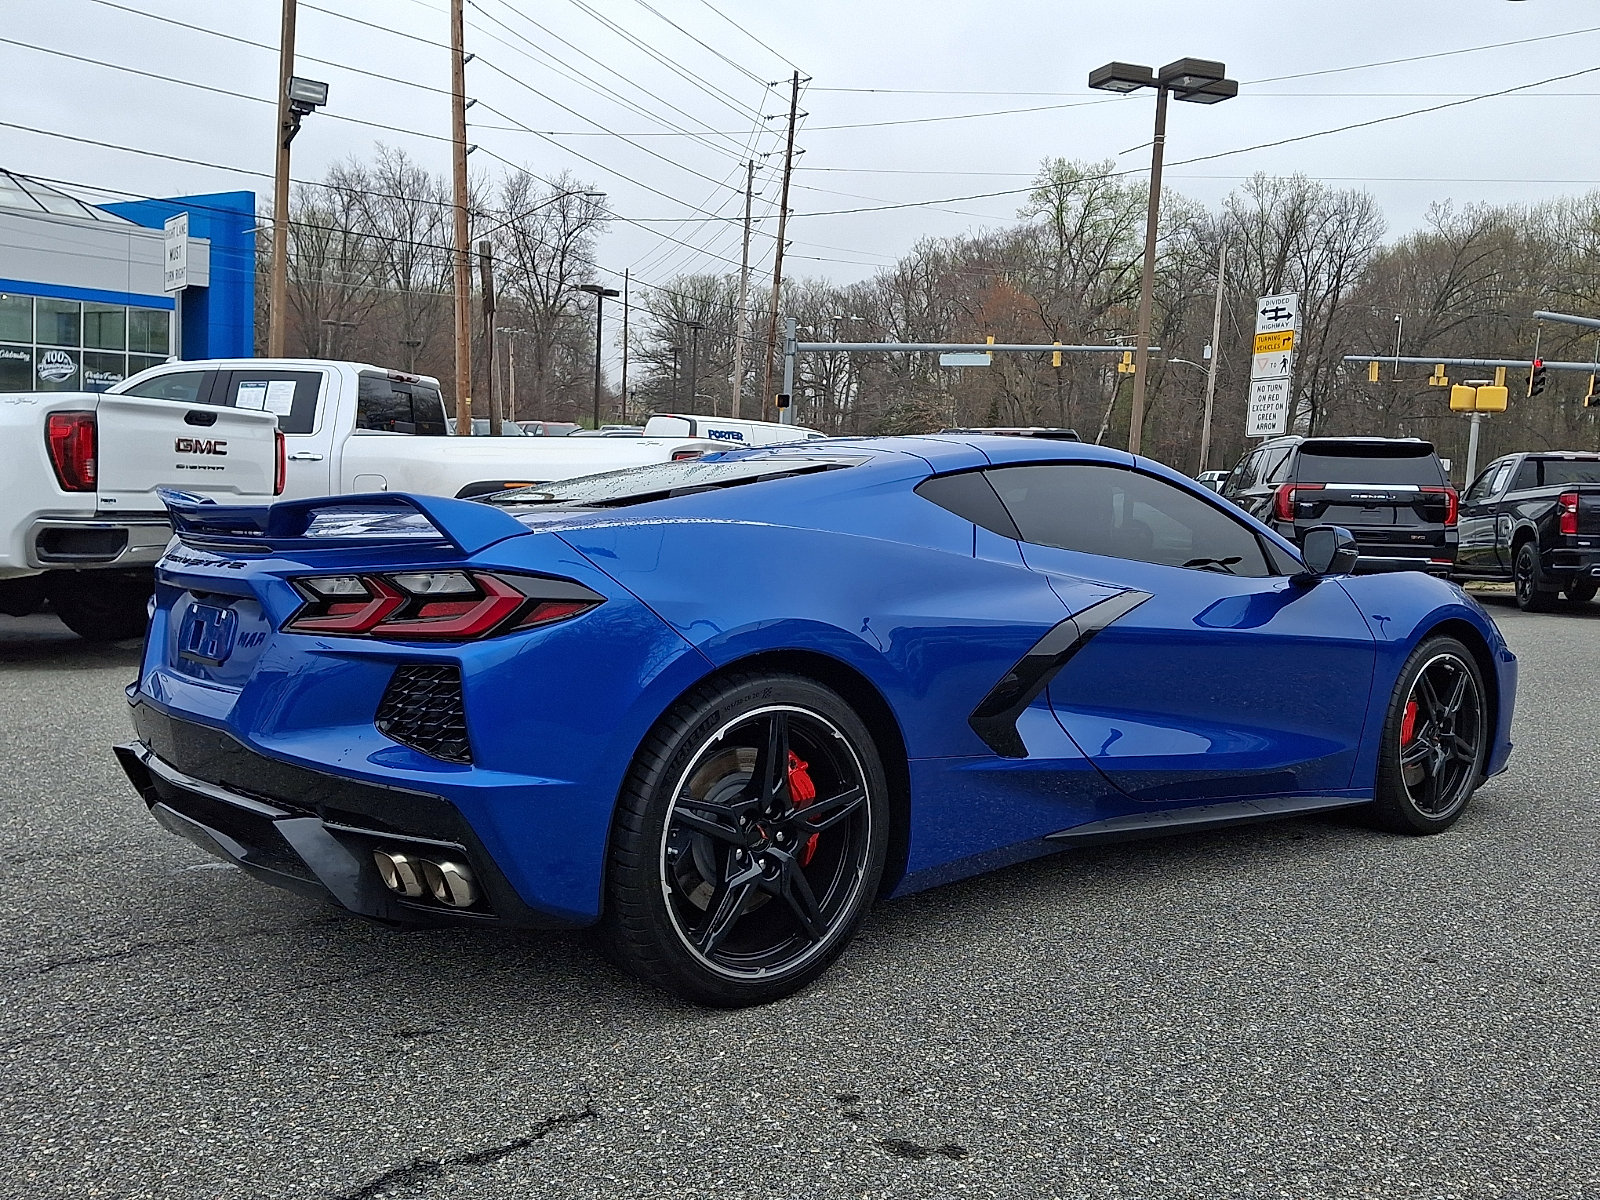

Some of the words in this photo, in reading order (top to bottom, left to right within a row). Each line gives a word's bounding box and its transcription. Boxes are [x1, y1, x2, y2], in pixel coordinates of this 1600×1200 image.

[170, 244, 181, 261] MUST
[1265, 298, 1289, 306] DIVIDED
[1261, 321, 1289, 330] HIGHWAY
[1257, 335, 1280, 343] TURNING
[47, 351, 64, 363] 100
[1257, 385, 1266, 393] NO
[1267, 384, 1282, 392] TURN
[1257, 395, 1266, 403] ON
[1268, 393, 1279, 402] RED
[1252, 404, 1273, 412] EXCEPT
[1257, 413, 1277, 421] GREEN
[1255, 422, 1277, 431] ARROW
[708, 429, 744, 442] PORTER
[175, 437, 228, 456] GMC
[175, 463, 225, 471] SIERRA
